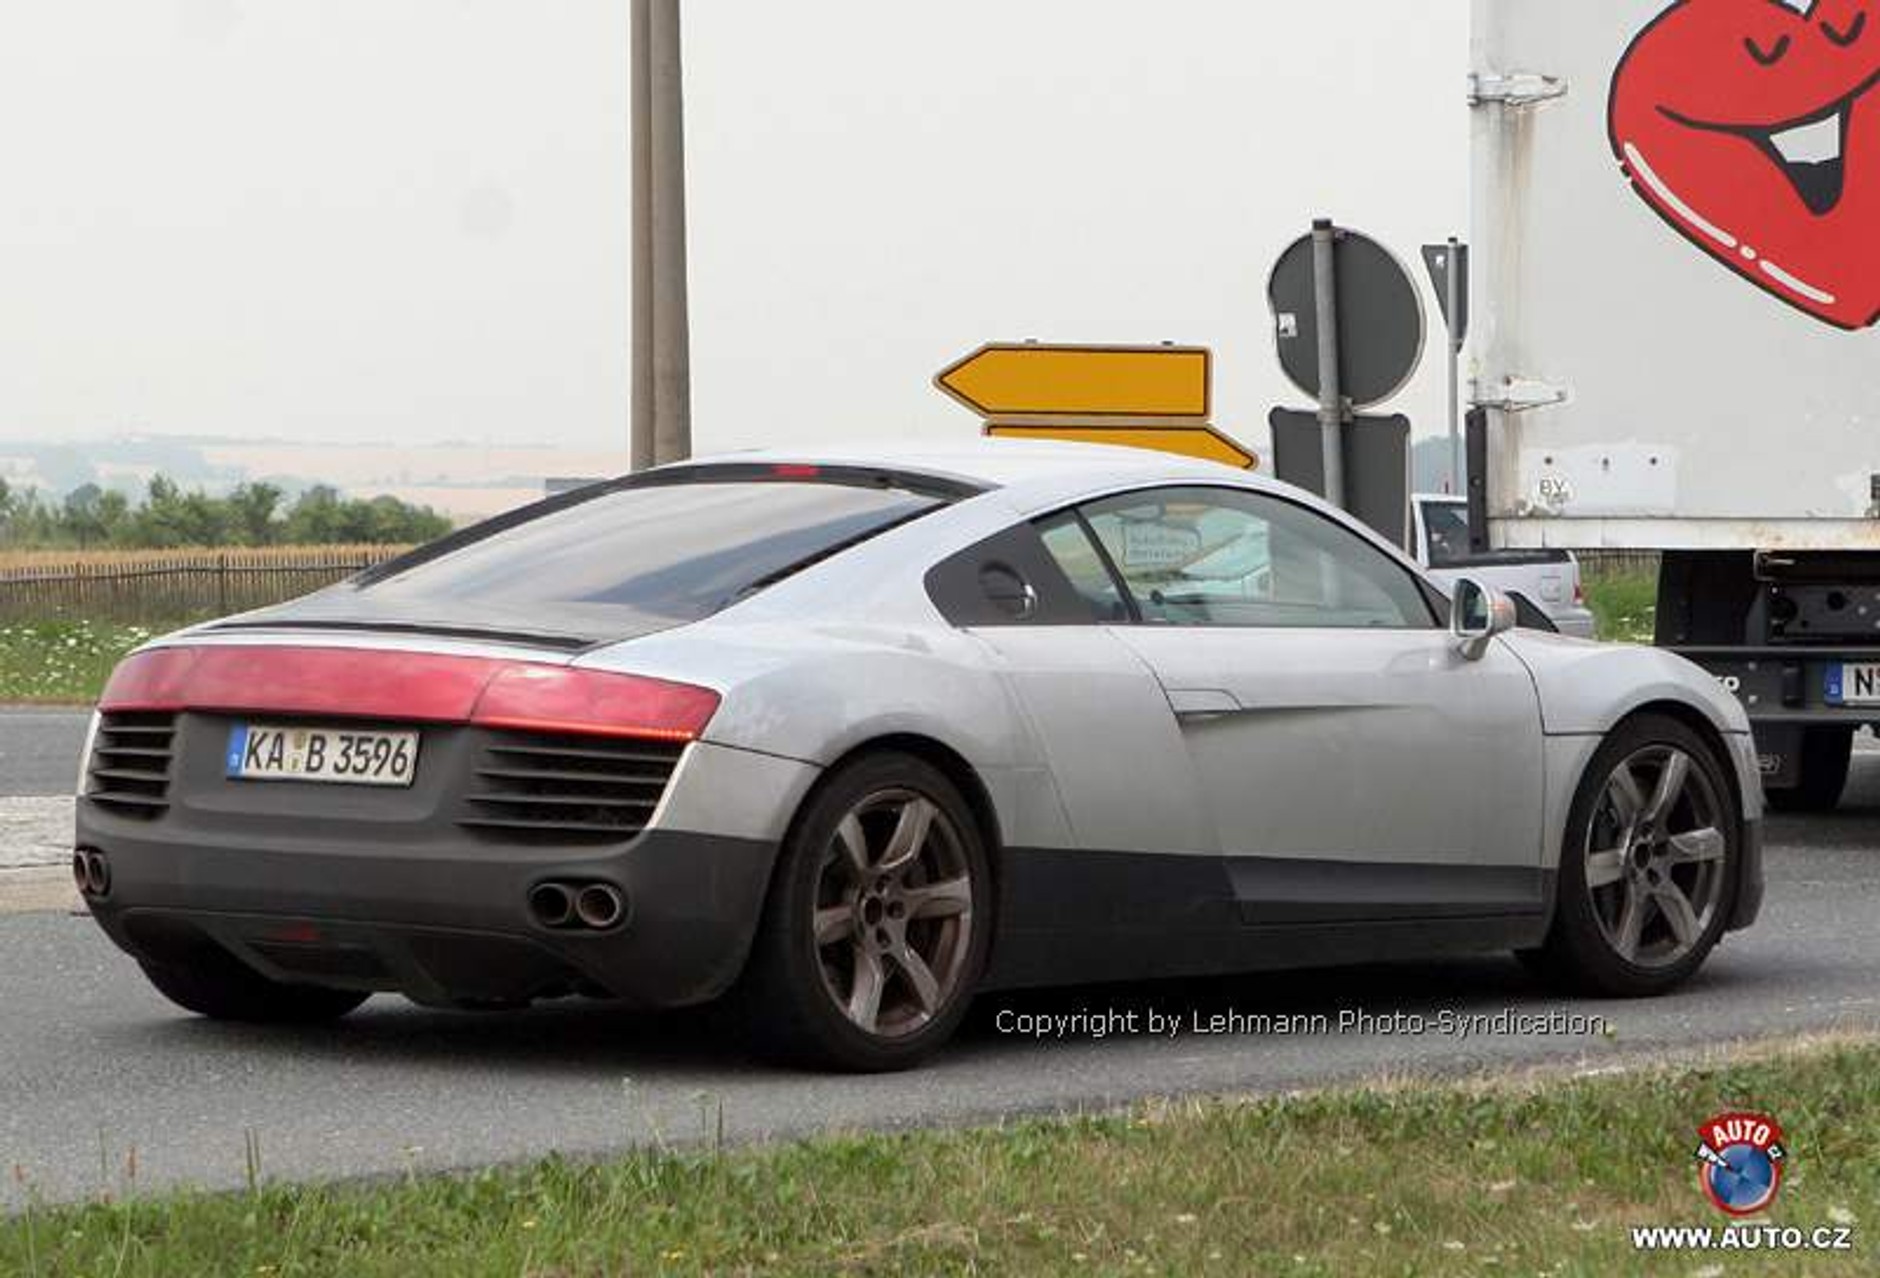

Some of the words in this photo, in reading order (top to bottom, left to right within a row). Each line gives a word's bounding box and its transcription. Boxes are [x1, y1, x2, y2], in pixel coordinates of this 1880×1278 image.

[244, 731, 285, 771] KA
[305, 734, 327, 773] B
[333, 734, 408, 777] 3596
